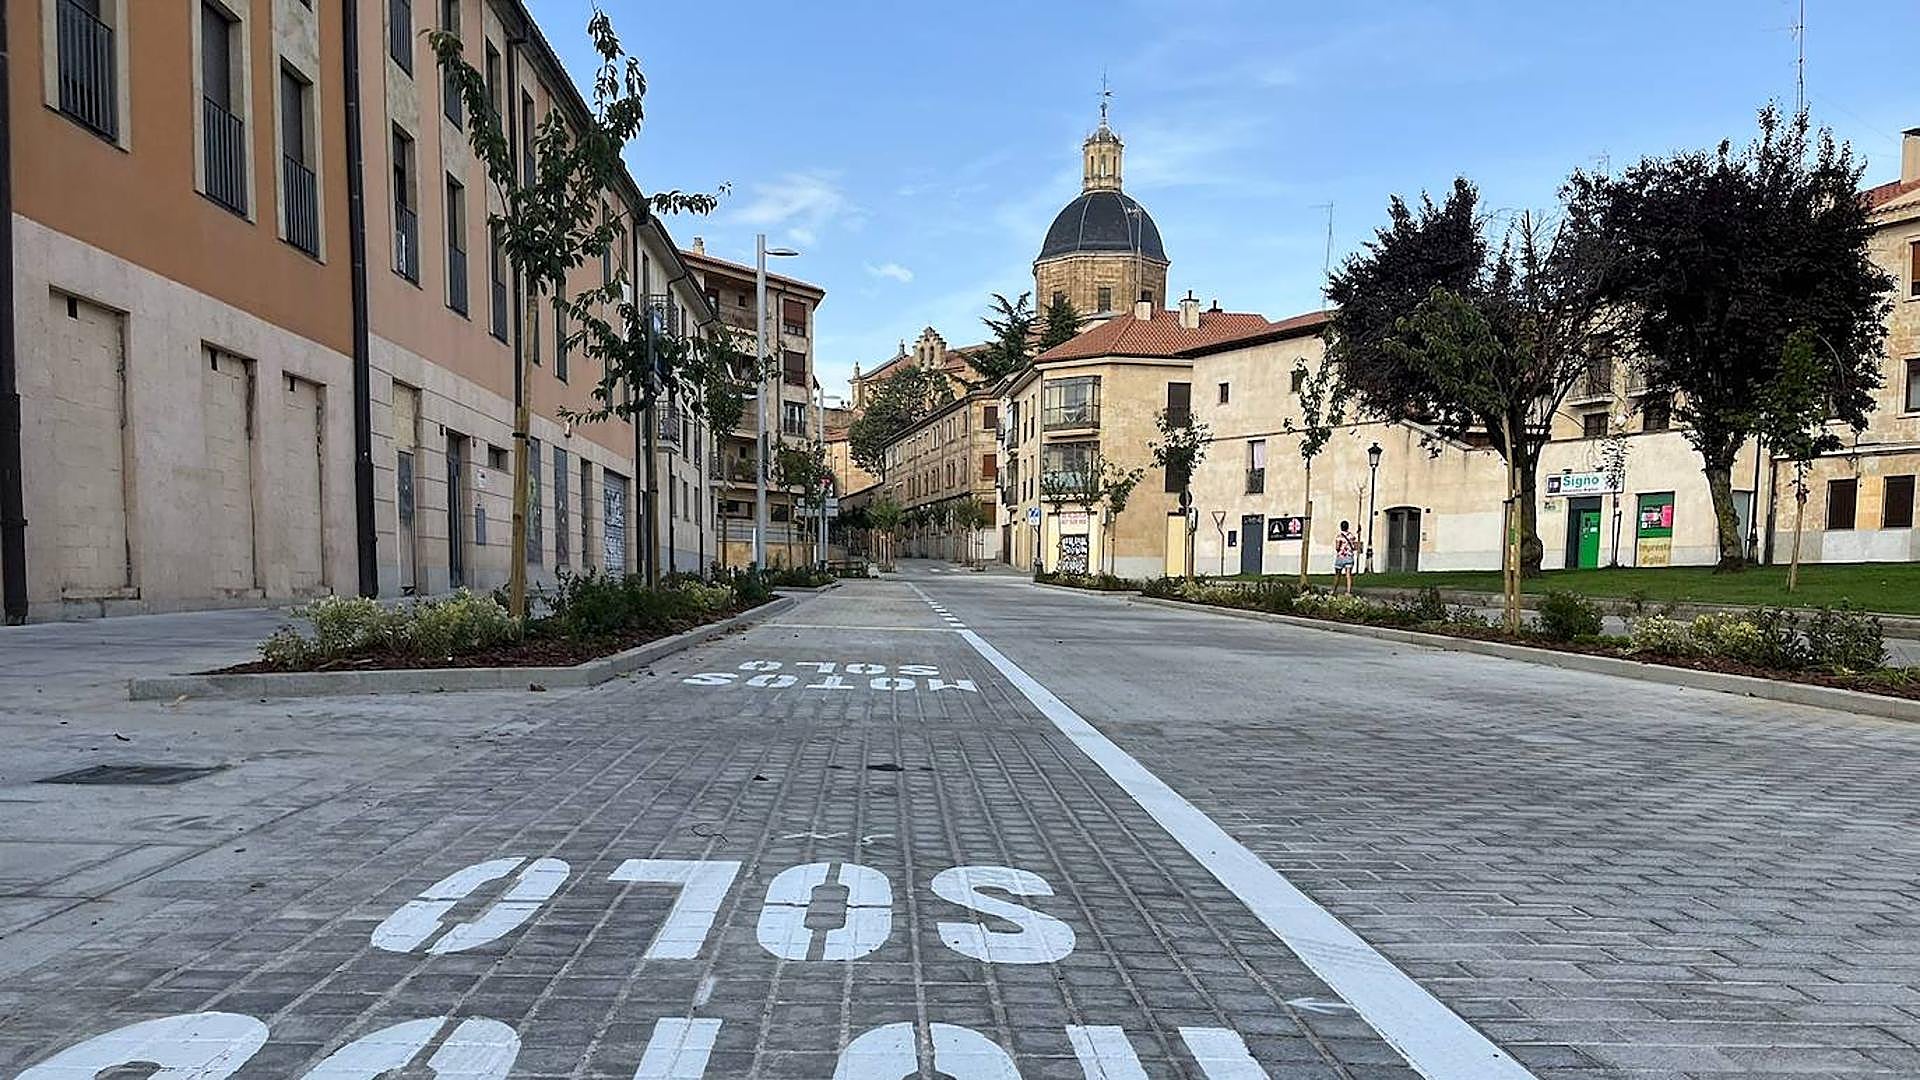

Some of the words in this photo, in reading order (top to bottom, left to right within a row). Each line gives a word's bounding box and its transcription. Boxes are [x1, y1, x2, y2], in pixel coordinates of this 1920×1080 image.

[1563, 475, 1600, 488] Signo
[738, 660, 940, 676] SOLO
[682, 672, 977, 692] MOTOS
[369, 856, 1077, 965] SOLO
